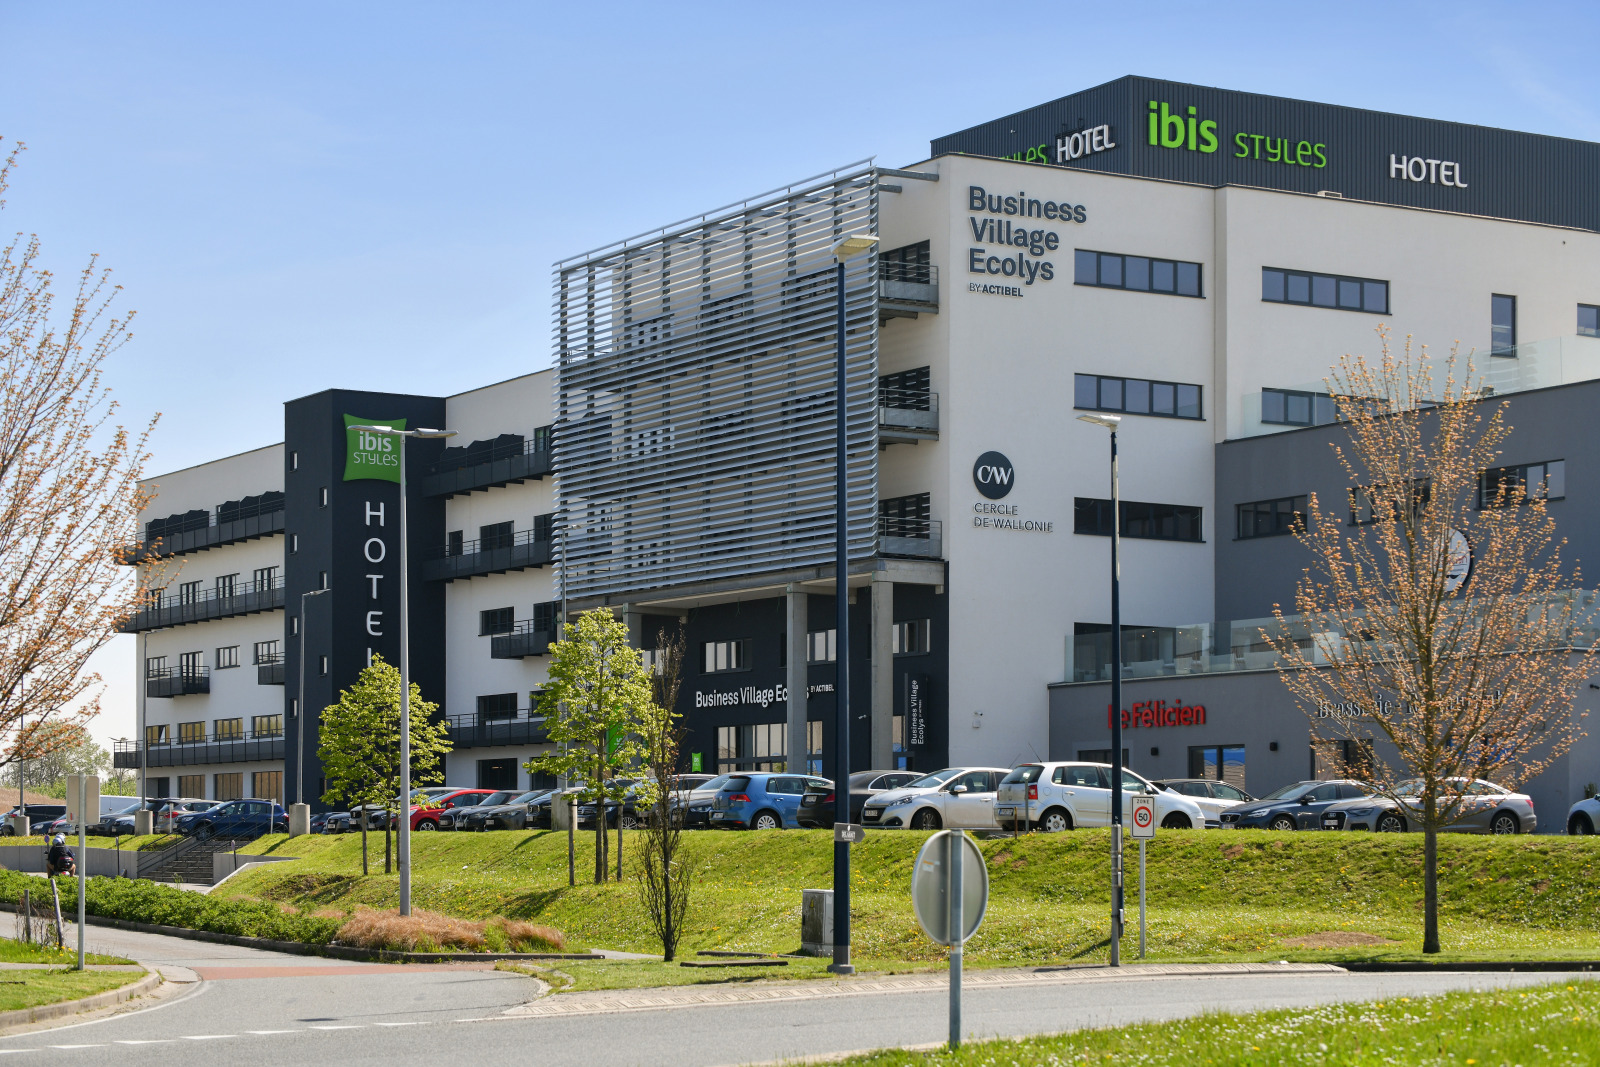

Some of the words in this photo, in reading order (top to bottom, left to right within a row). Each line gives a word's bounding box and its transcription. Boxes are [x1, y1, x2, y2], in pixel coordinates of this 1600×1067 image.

[1057, 124, 1116, 163] HOTEL
[1148, 100, 1219, 154] ibis
[1389, 153, 1468, 188] HOTEL
[969, 185, 1087, 224] Business
[969, 216, 1060, 257] Village
[969, 247, 1055, 286] Ecolys
[969, 282, 981, 293] BY
[981, 284, 1024, 298] ACTIBEL
[359, 430, 393, 453] ibis
[974, 502, 1019, 516] CERCLE
[973, 516, 990, 528] DE
[992, 518, 1054, 533] WALLONIE
[695, 689, 739, 708] Business
[740, 686, 774, 708] Village
[910, 679, 919, 707] Village
[1317, 694, 1392, 719] Brassie
[910, 708, 918, 745] Business
[1132, 699, 1206, 728] Félicien
[917, 718, 925, 745] Ecolys
[1138, 812, 1148, 822] 50
